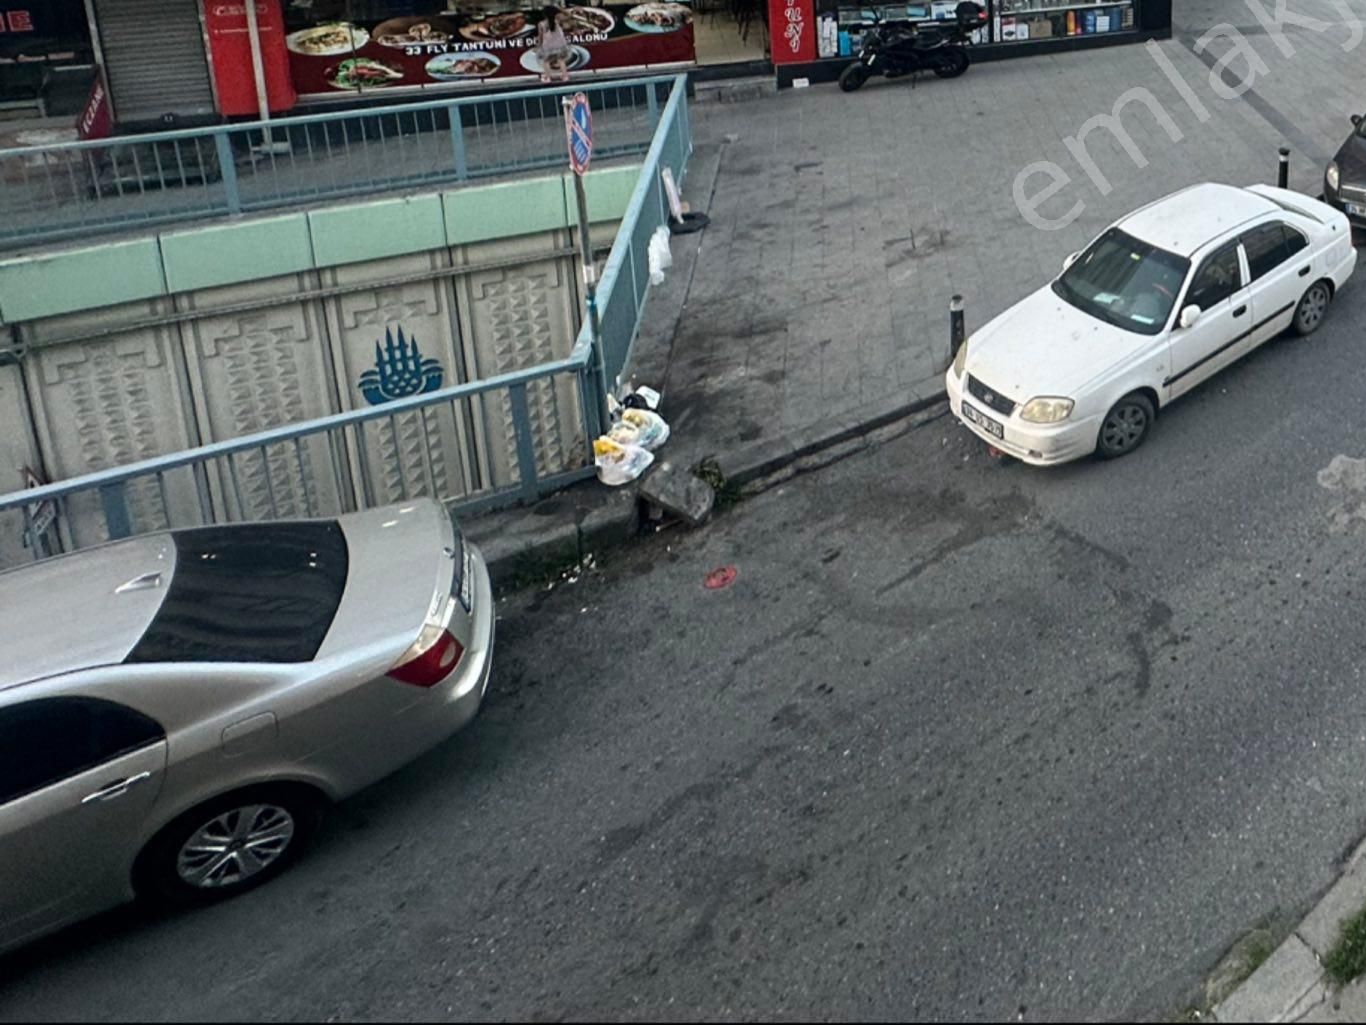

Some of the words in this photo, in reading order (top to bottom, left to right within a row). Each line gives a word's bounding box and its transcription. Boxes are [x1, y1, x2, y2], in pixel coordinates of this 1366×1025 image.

[405, 46, 421, 56] 33
[427, 43, 449, 54] FLY
[509, 38, 524, 48] VE
